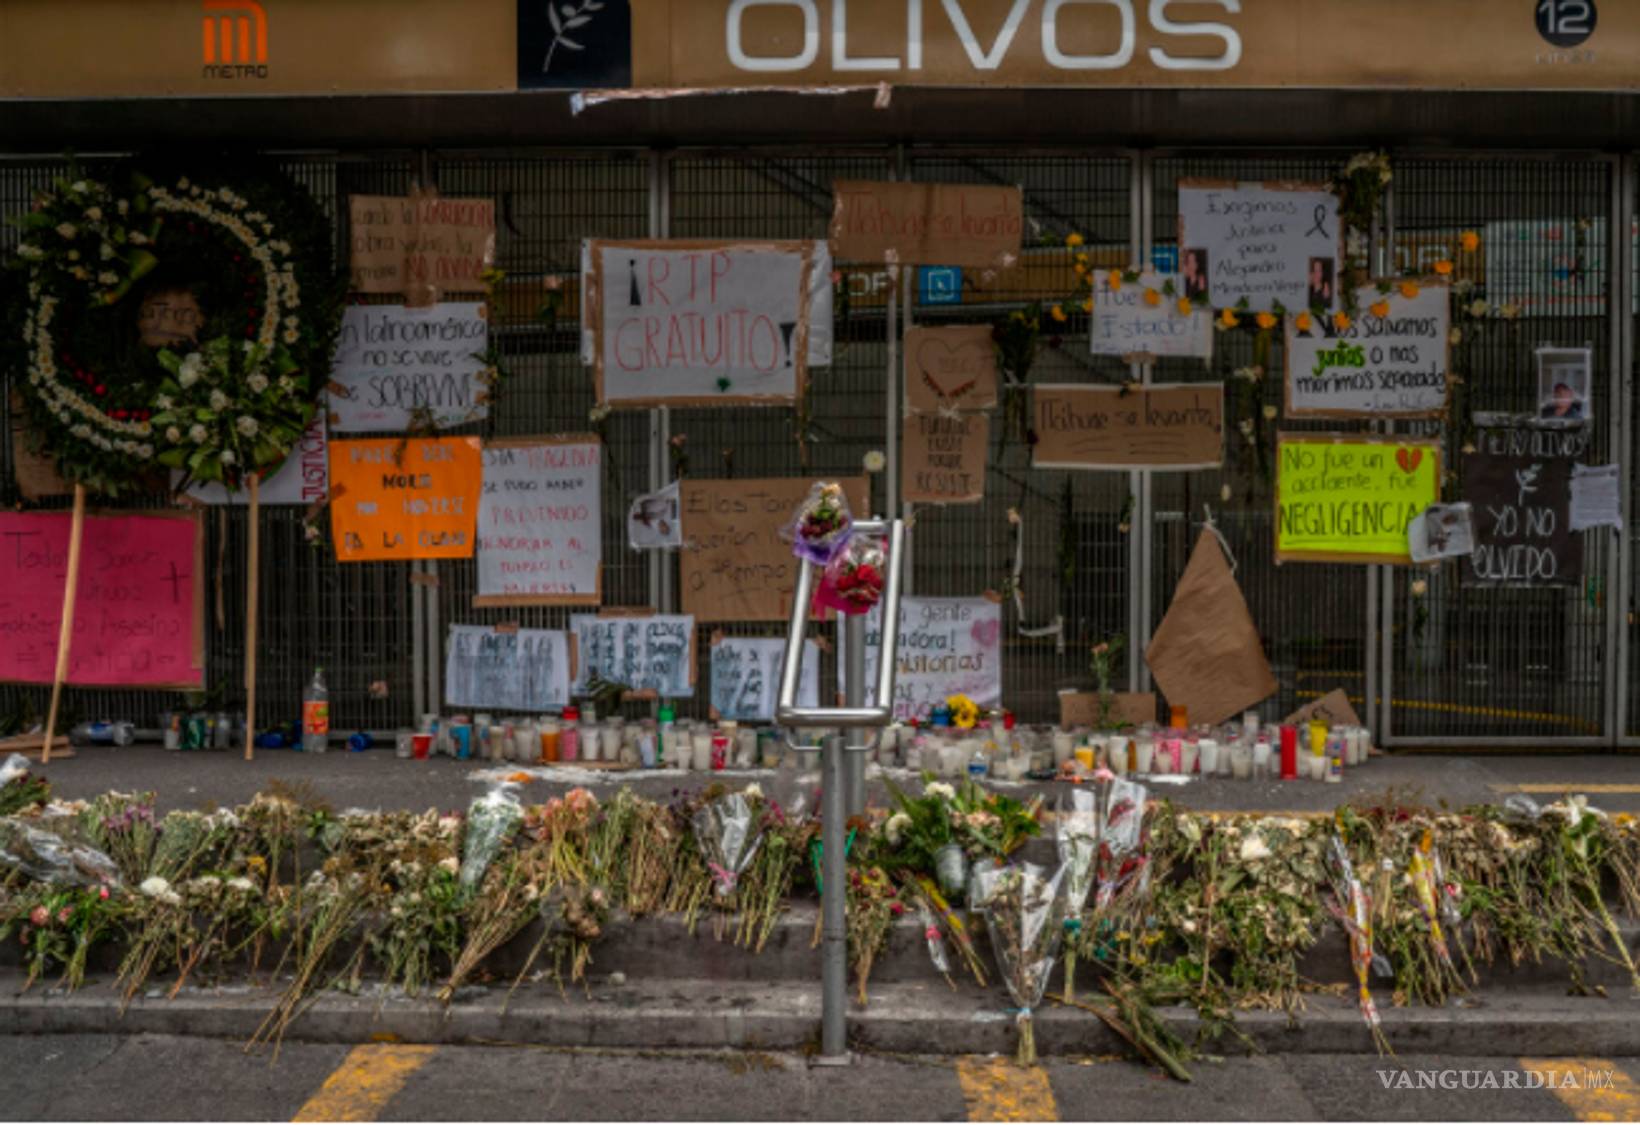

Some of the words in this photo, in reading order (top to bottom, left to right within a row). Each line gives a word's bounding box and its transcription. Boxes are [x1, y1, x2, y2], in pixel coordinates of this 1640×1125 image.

[1539, 0, 1589, 33] 12
[726, 0, 1243, 72] OLIVOS
[203, 65, 268, 79] METRO
[615, 309, 797, 372] GRATUITO!
[1369, 346, 1384, 365] o
[1285, 446, 1316, 471] No
[1324, 446, 1355, 476] fue
[1362, 454, 1384, 469] un
[1488, 505, 1518, 536] YO
[1526, 505, 1555, 537] NO
